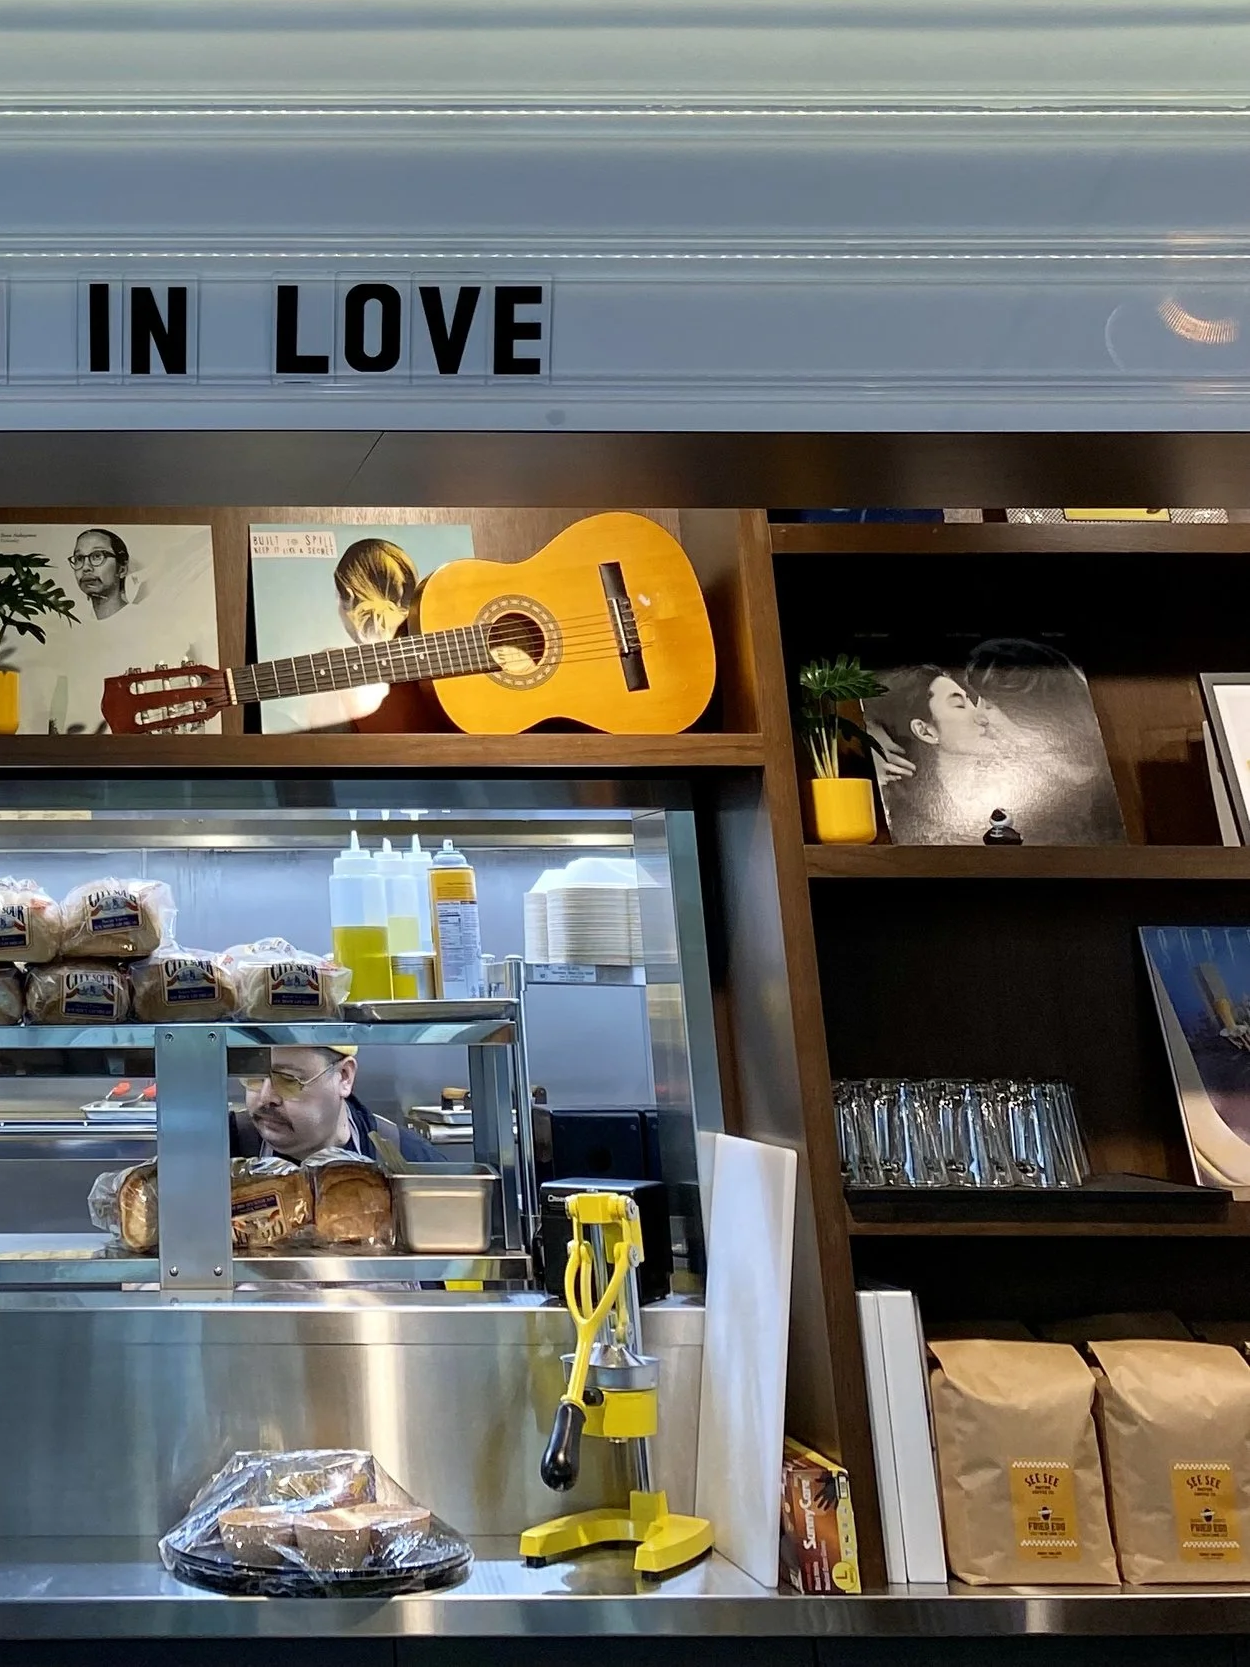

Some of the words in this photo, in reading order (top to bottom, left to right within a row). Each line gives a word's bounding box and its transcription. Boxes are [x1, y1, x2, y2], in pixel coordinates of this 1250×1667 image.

[90, 284, 187, 374] IN
[276, 284, 542, 374] LOVE
[253, 535, 279, 546] BUILT
[305, 534, 334, 548] SPILL
[308, 547, 334, 556] SECRET
[0, 905, 25, 924] SOUR
[165, 959, 189, 979] CITY
[270, 962, 295, 982] CITY
[295, 963, 319, 985] SOUR
[66, 972, 91, 990] CITY
[91, 973, 115, 993] SOUR
[1024, 1473, 1040, 1488] SEE
[1043, 1473, 1060, 1488] SEE
[1186, 1475, 1203, 1490] SEE
[1205, 1475, 1222, 1490] SEE
[799, 1478, 817, 1551] SunnyCare
